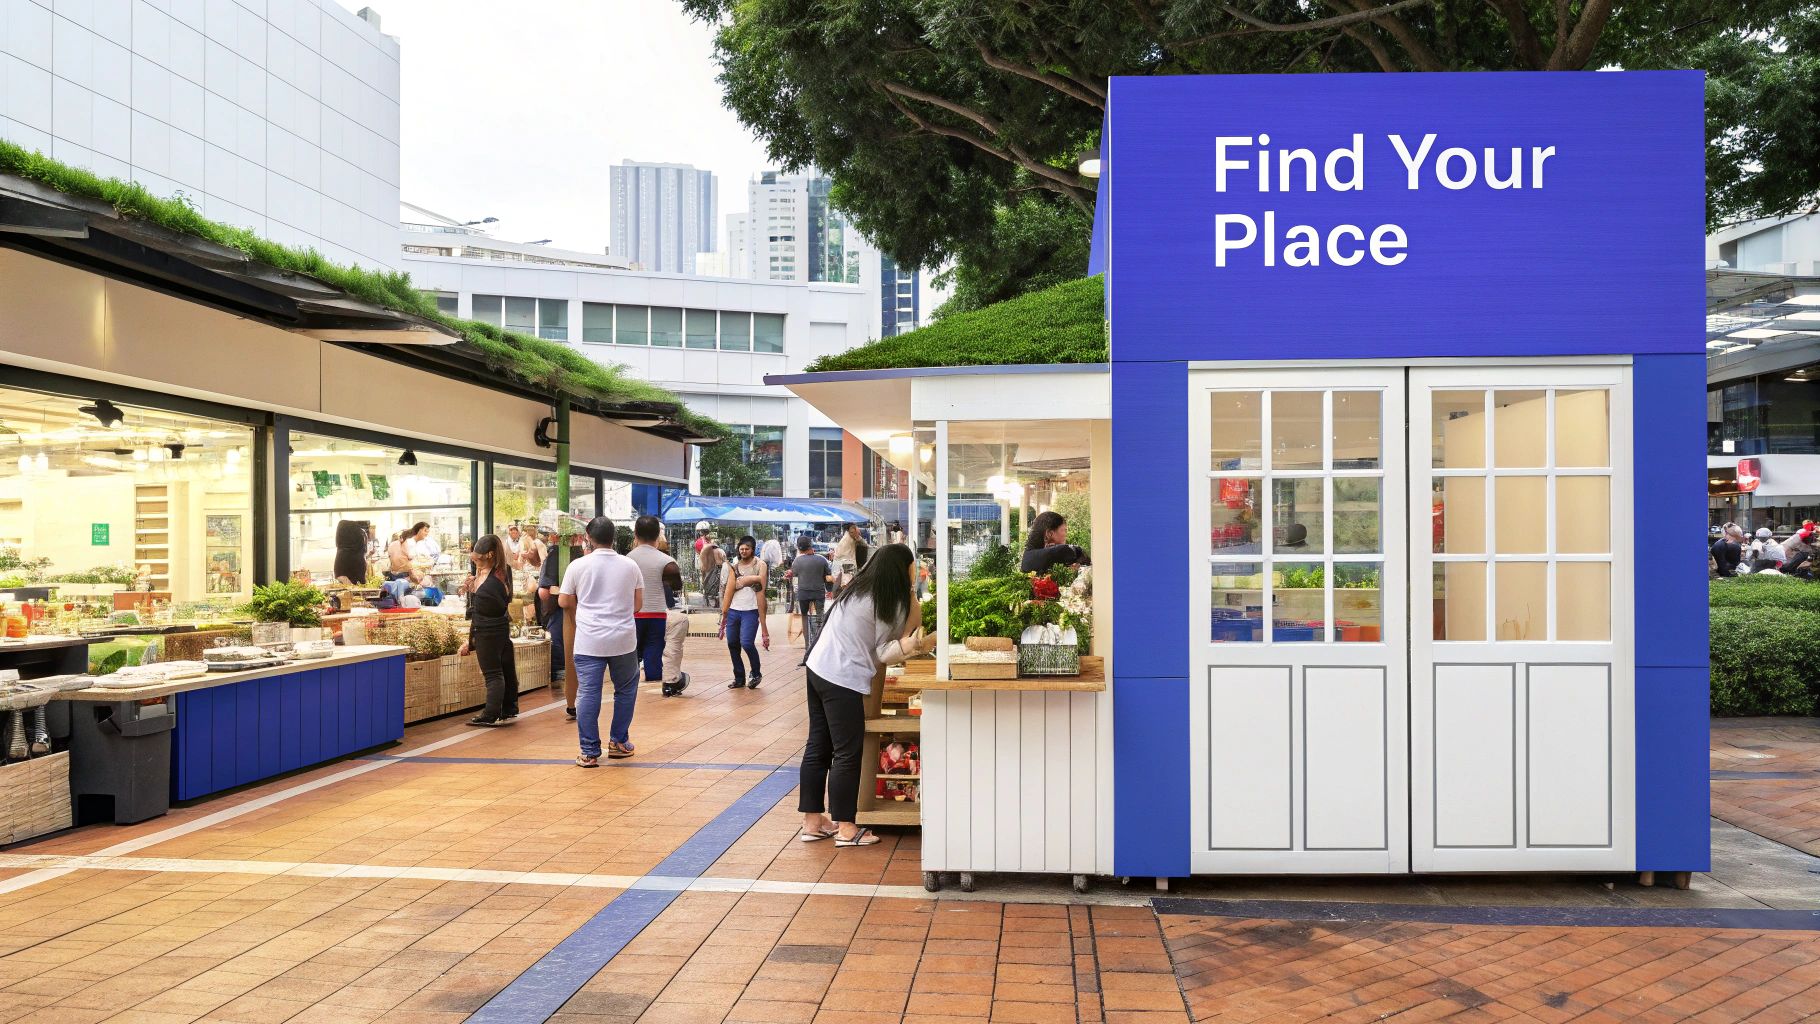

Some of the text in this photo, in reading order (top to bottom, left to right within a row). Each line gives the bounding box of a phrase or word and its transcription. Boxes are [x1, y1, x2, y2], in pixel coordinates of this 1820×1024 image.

[1215, 133, 1556, 192] Find Your
[1215, 210, 1408, 268] Place
